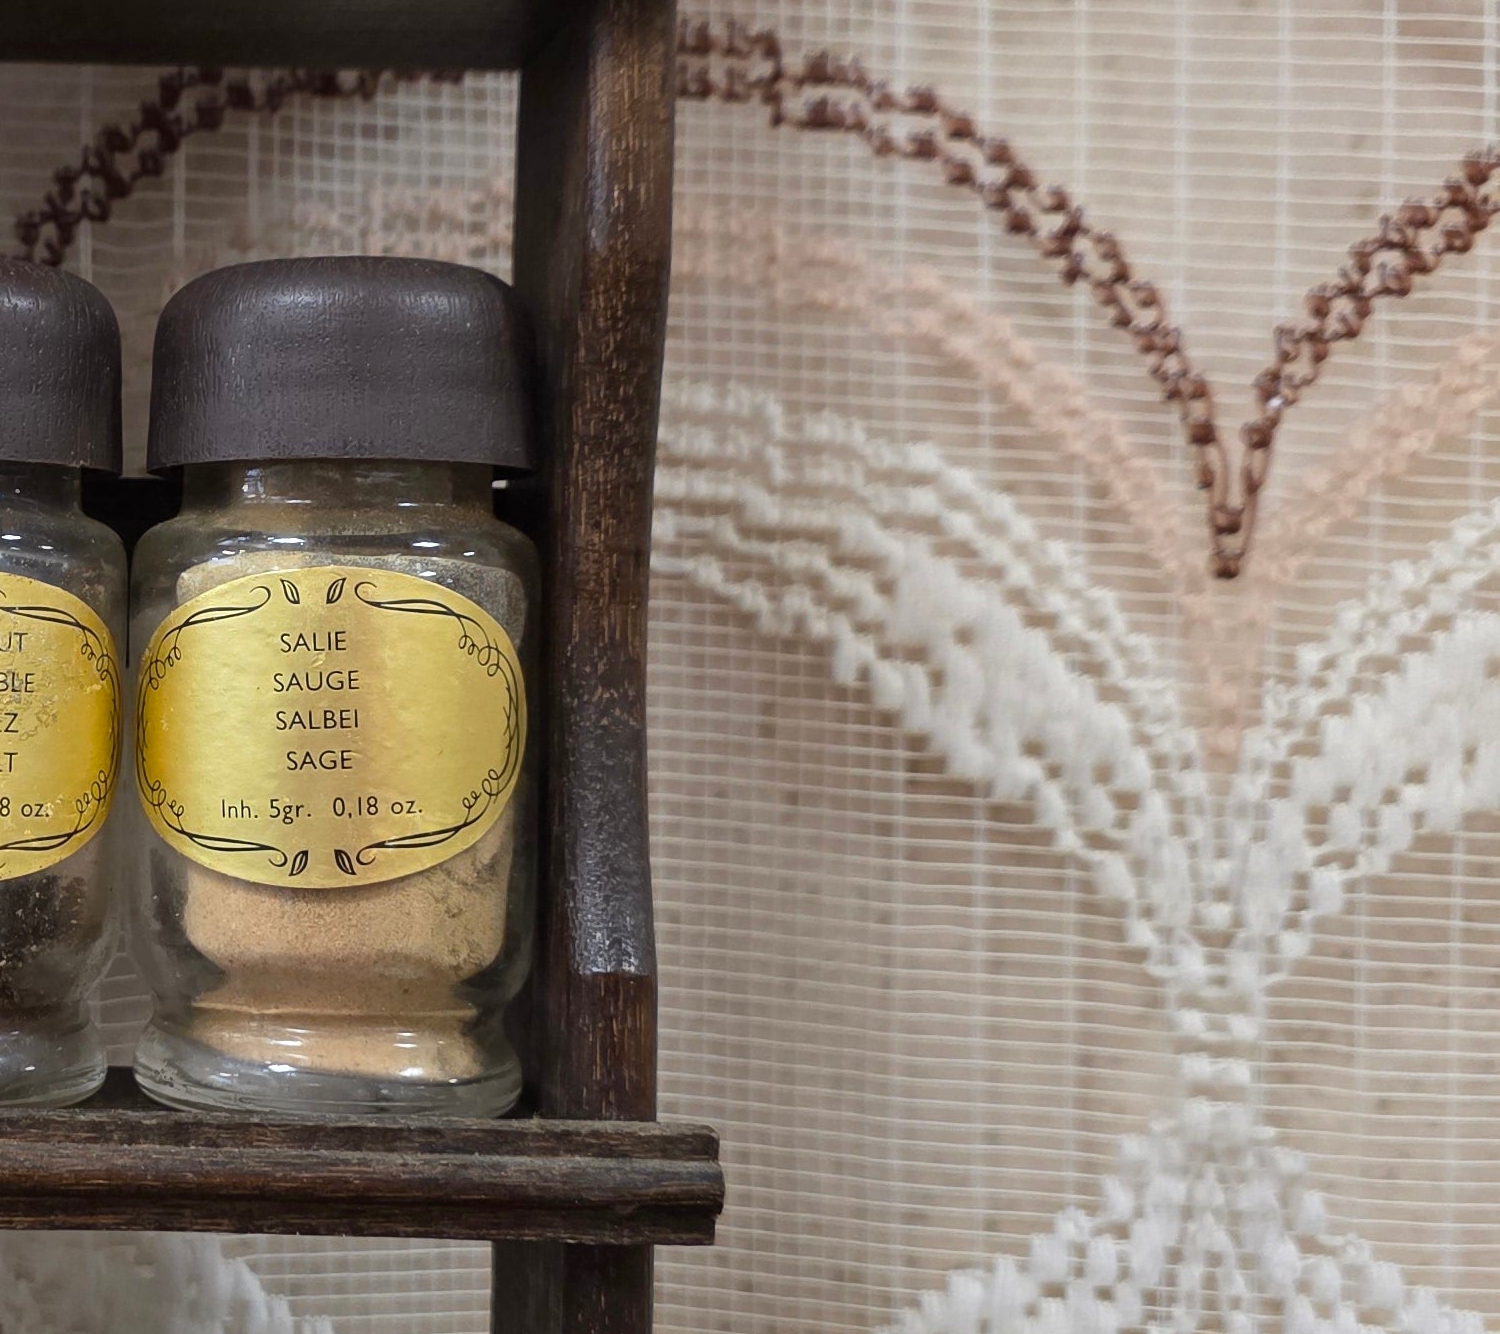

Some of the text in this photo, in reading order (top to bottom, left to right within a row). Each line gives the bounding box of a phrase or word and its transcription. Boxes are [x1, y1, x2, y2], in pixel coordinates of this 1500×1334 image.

[280, 631, 347, 652] SALIE
[273, 670, 360, 693] SAUGE
[276, 709, 358, 730] SALBEI
[286, 749, 353, 770] SAGE
[21, 802, 49, 818] oz.
[221, 796, 423, 824] Inh. 5gr. 0,18 oz.
